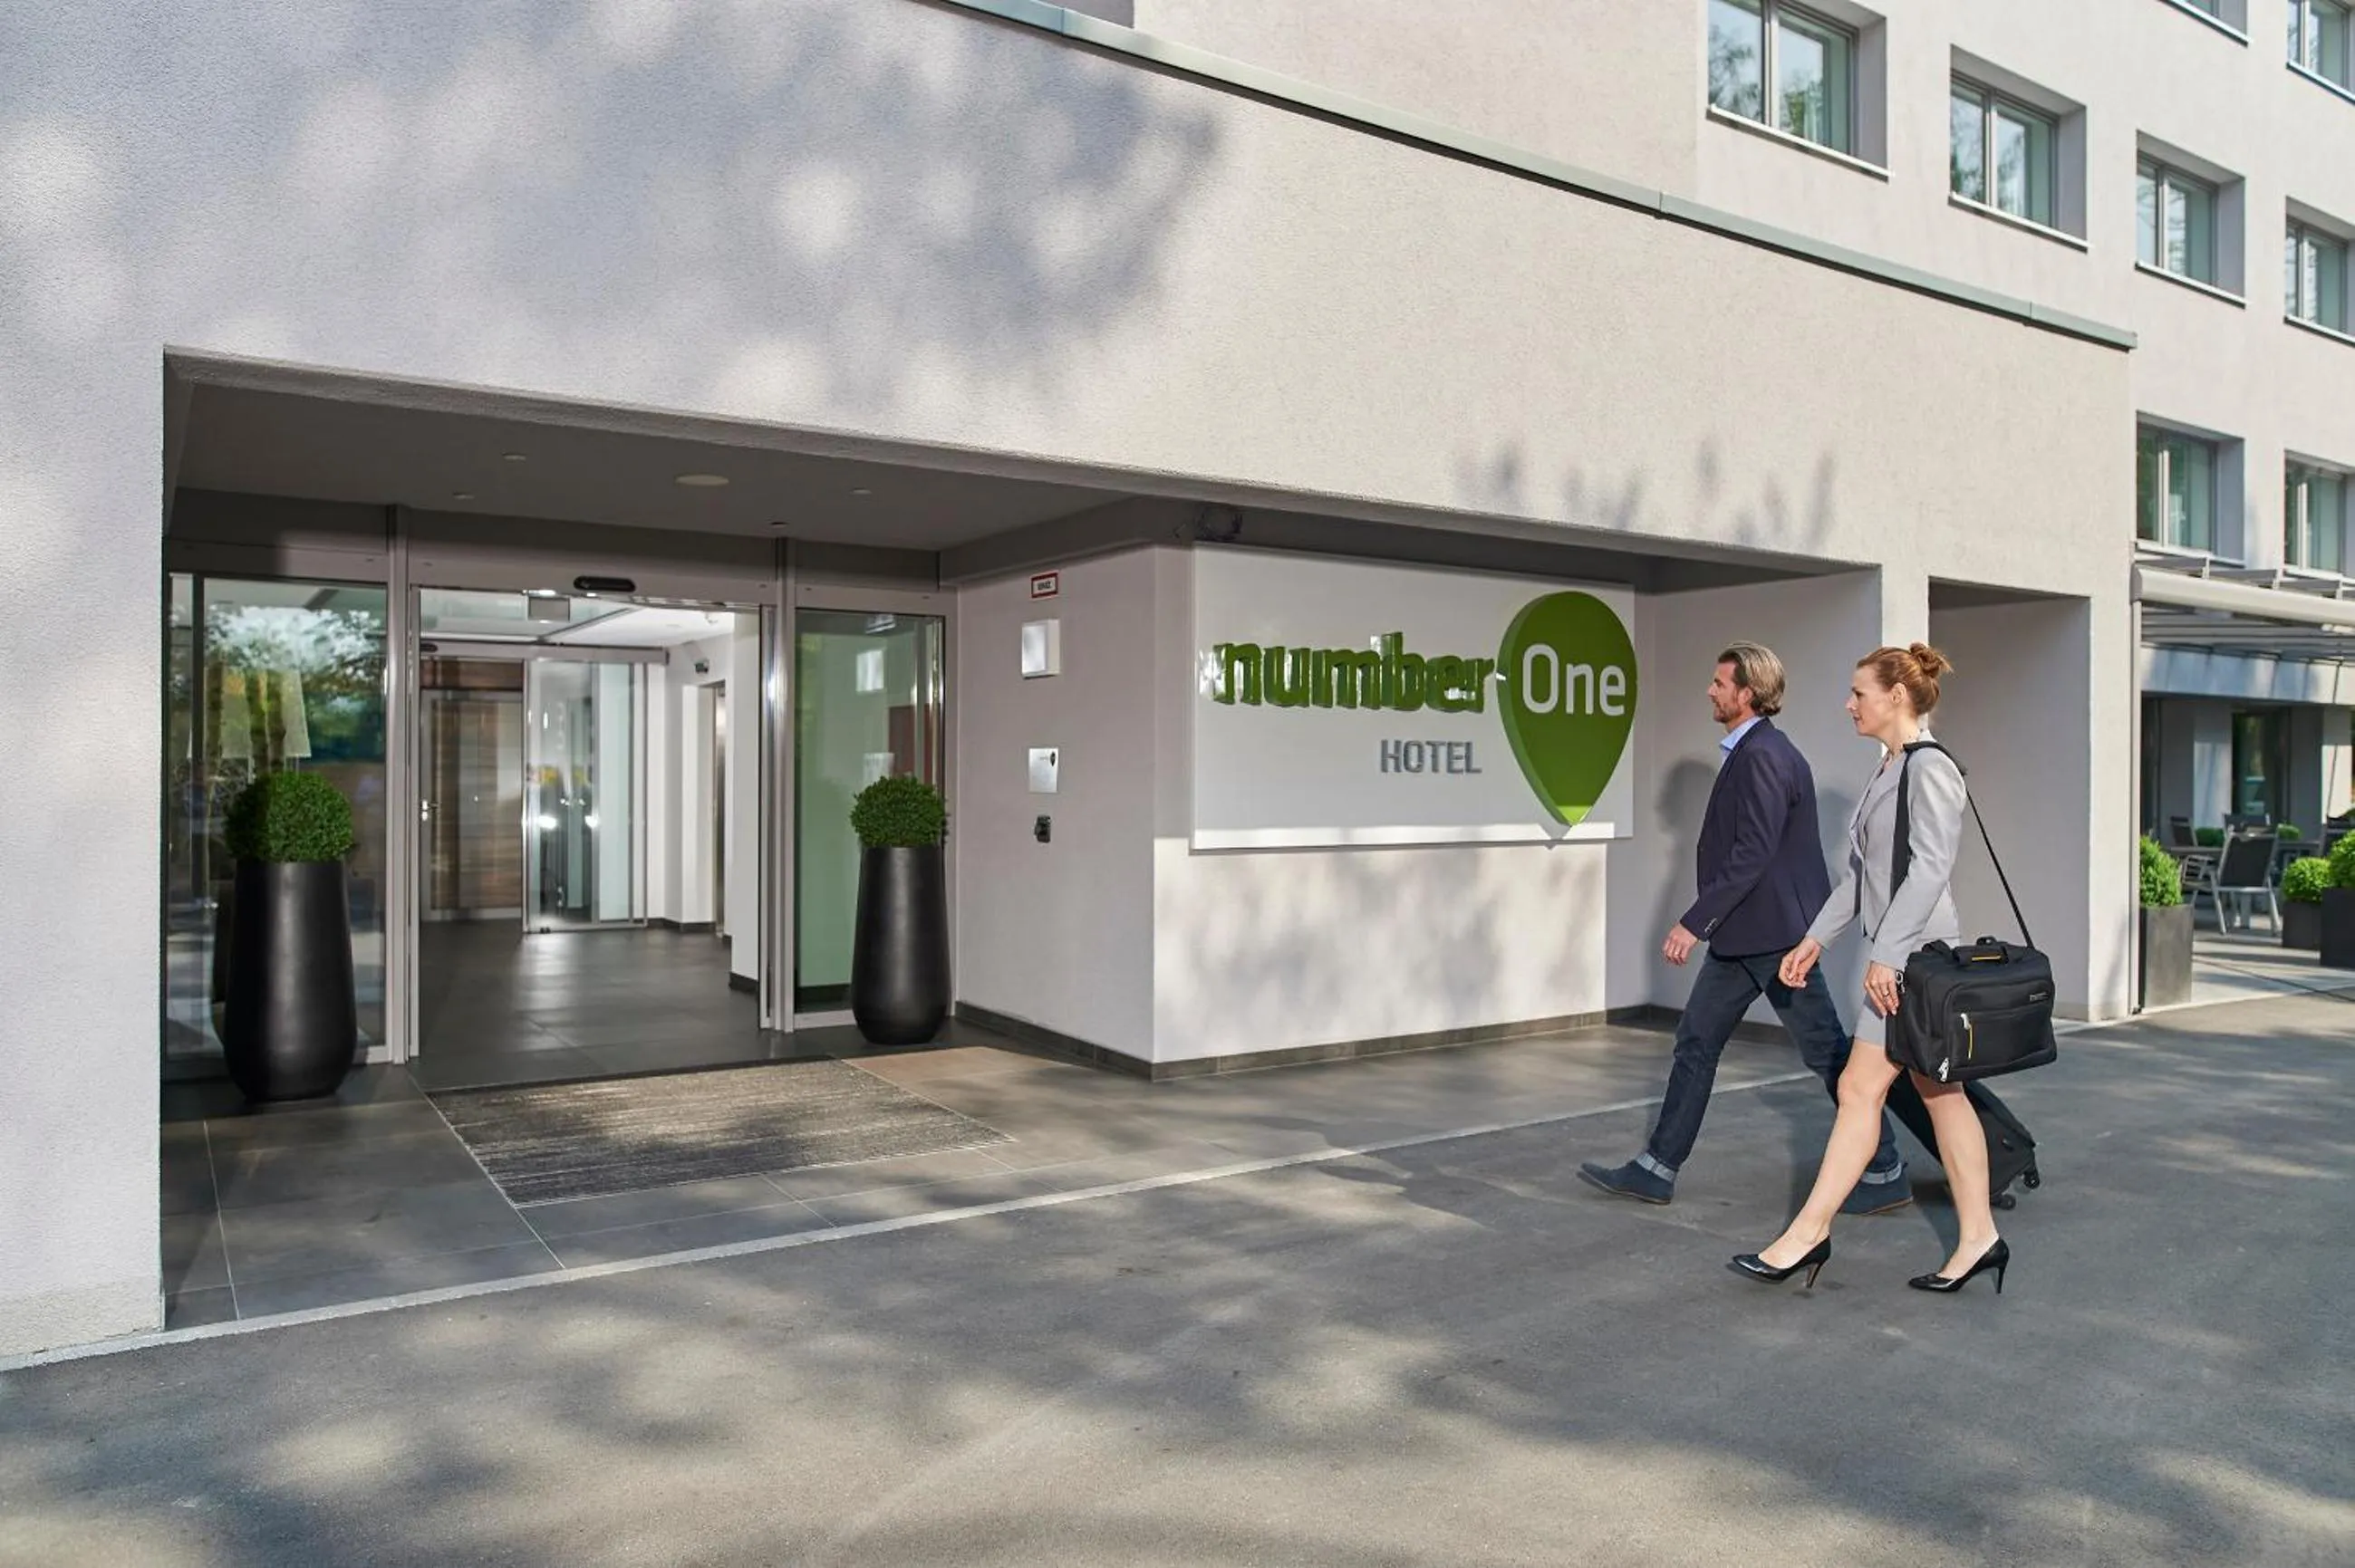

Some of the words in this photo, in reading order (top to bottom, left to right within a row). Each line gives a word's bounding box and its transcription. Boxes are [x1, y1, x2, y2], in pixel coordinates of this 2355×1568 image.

[1211, 632, 1494, 713] number
[1522, 643, 1626, 716] One
[1380, 739, 1482, 774] HOTEL
